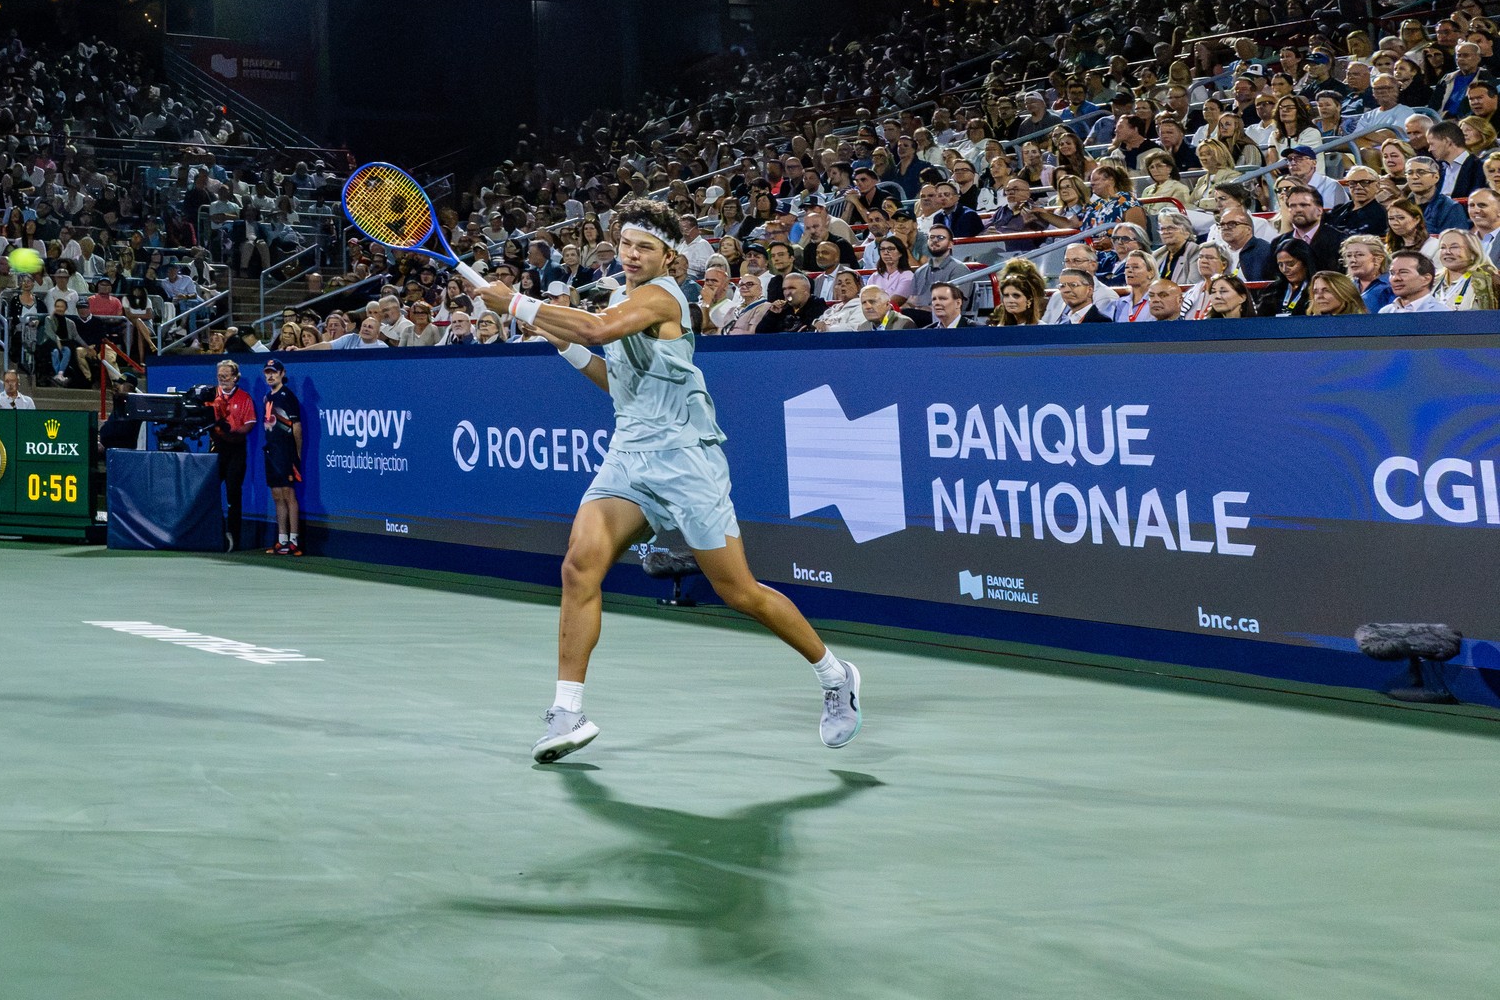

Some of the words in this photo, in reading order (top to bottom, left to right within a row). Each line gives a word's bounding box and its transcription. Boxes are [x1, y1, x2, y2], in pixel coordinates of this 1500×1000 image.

[926, 403, 1156, 467] BANQUE
[25, 441, 80, 457] ROLEX
[487, 426, 608, 473] ROGERS
[325, 450, 373, 474] sémaglutide
[373, 452, 409, 476] injection
[28, 473, 78, 503] 0:56
[1373, 455, 1500, 525] CGI
[385, 519, 409, 534] bnc.ca
[931, 476, 1257, 557] NATIONALE
[793, 562, 833, 584] bnc.ca
[986, 575, 1025, 589] BANQUE
[987, 589, 1039, 604] NATIONALE
[1198, 606, 1260, 634] bnc.ca
